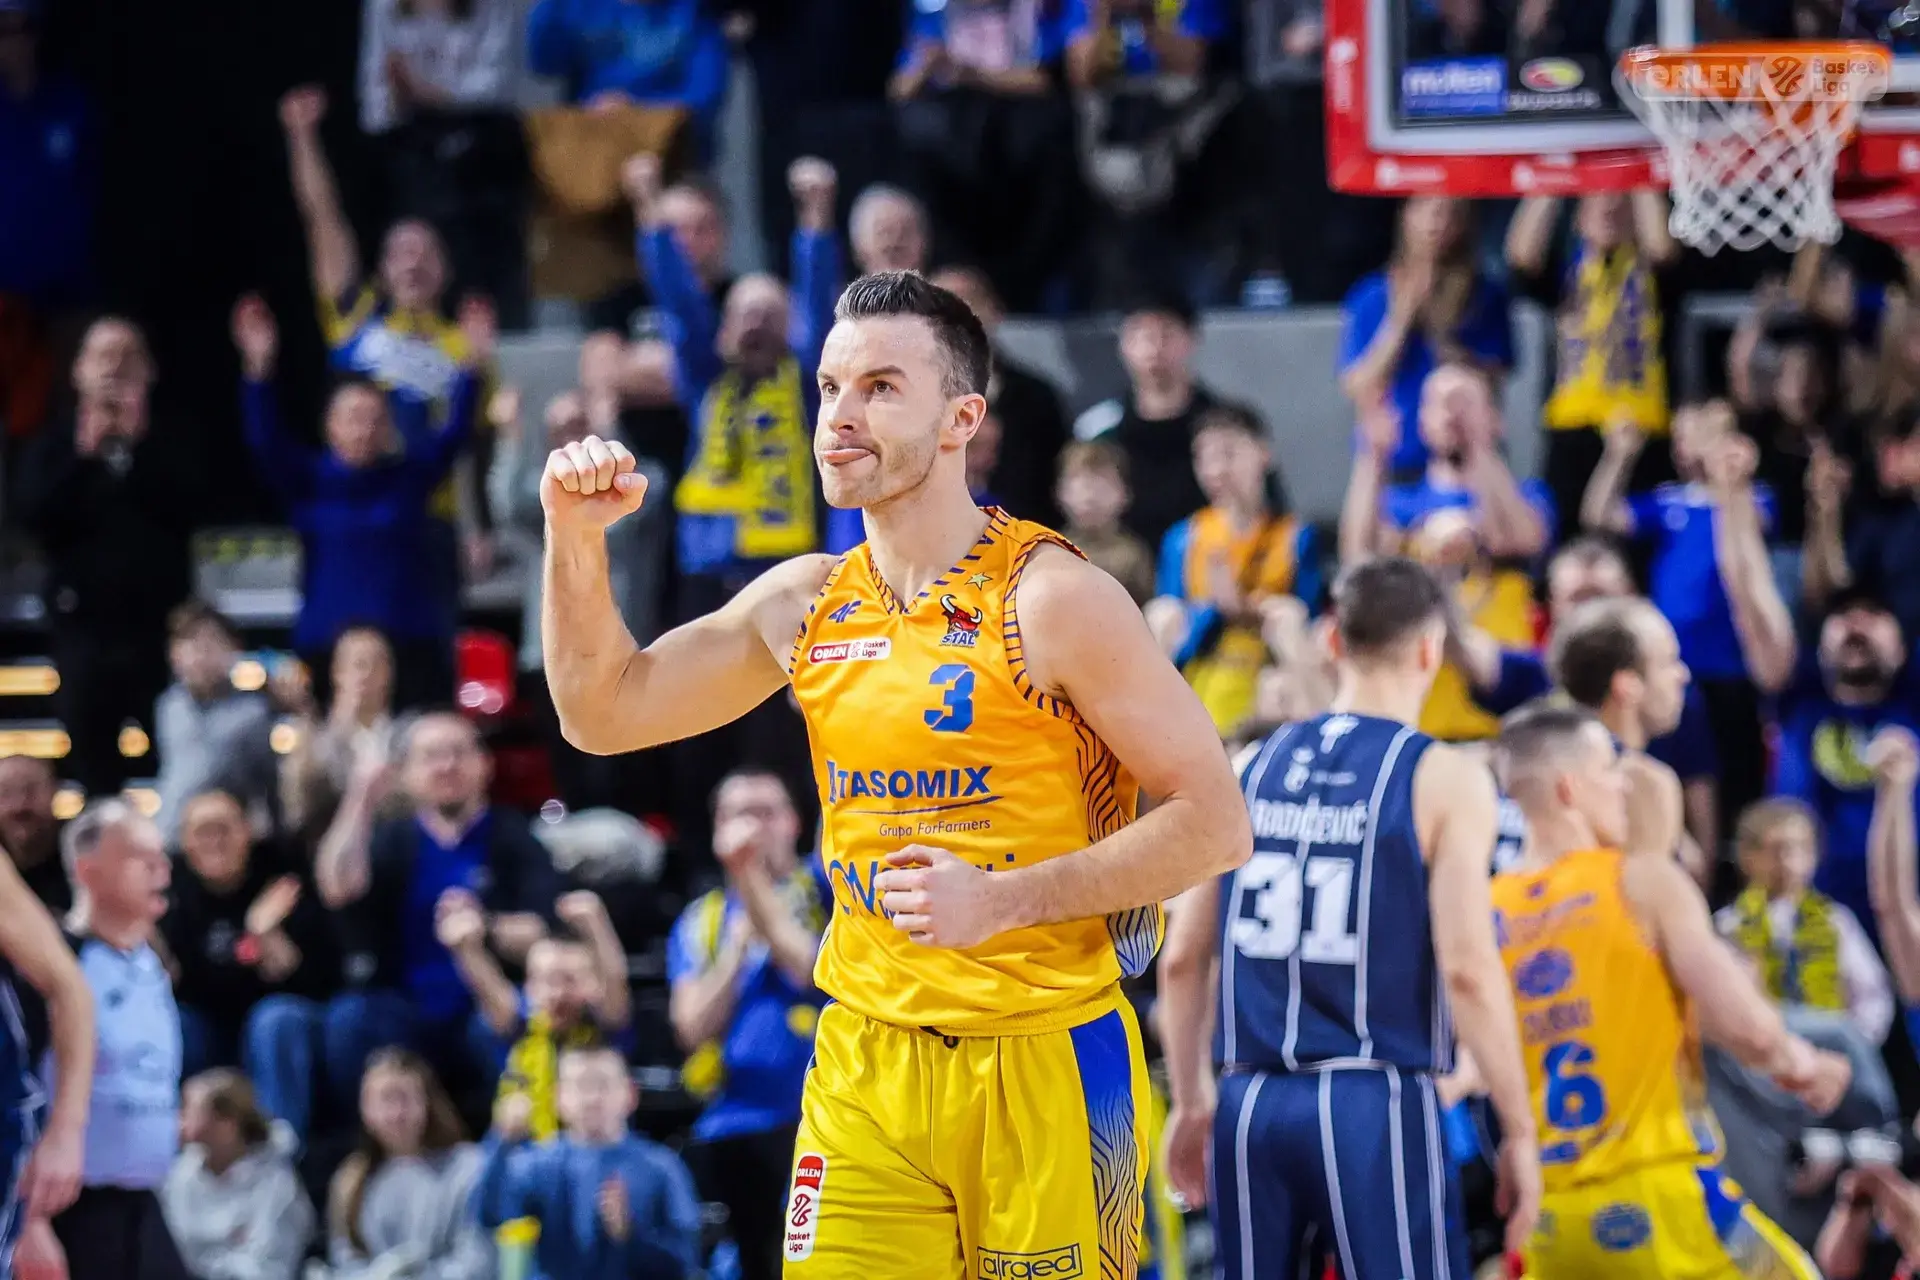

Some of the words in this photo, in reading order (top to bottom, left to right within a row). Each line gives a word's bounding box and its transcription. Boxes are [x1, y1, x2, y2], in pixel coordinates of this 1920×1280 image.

[1812, 58, 1876, 75] Basket
[1646, 64, 1751, 89] ORLEN
[1812, 76, 1849, 95] Liga
[813, 646, 848, 660] ORLEN
[863, 640, 887, 649] Basket
[862, 650, 877, 658] Liga
[923, 664, 976, 733] 3
[879, 823, 913, 840] Grupa
[917, 818, 991, 836] ForFarmers
[1229, 851, 1360, 965] 31
[1542, 1041, 1606, 1130] 6
[796, 1168, 821, 1177] ORLEN
[787, 1232, 810, 1241] Basket
[789, 1243, 803, 1253] Liga
[982, 1246, 1077, 1280] arged
